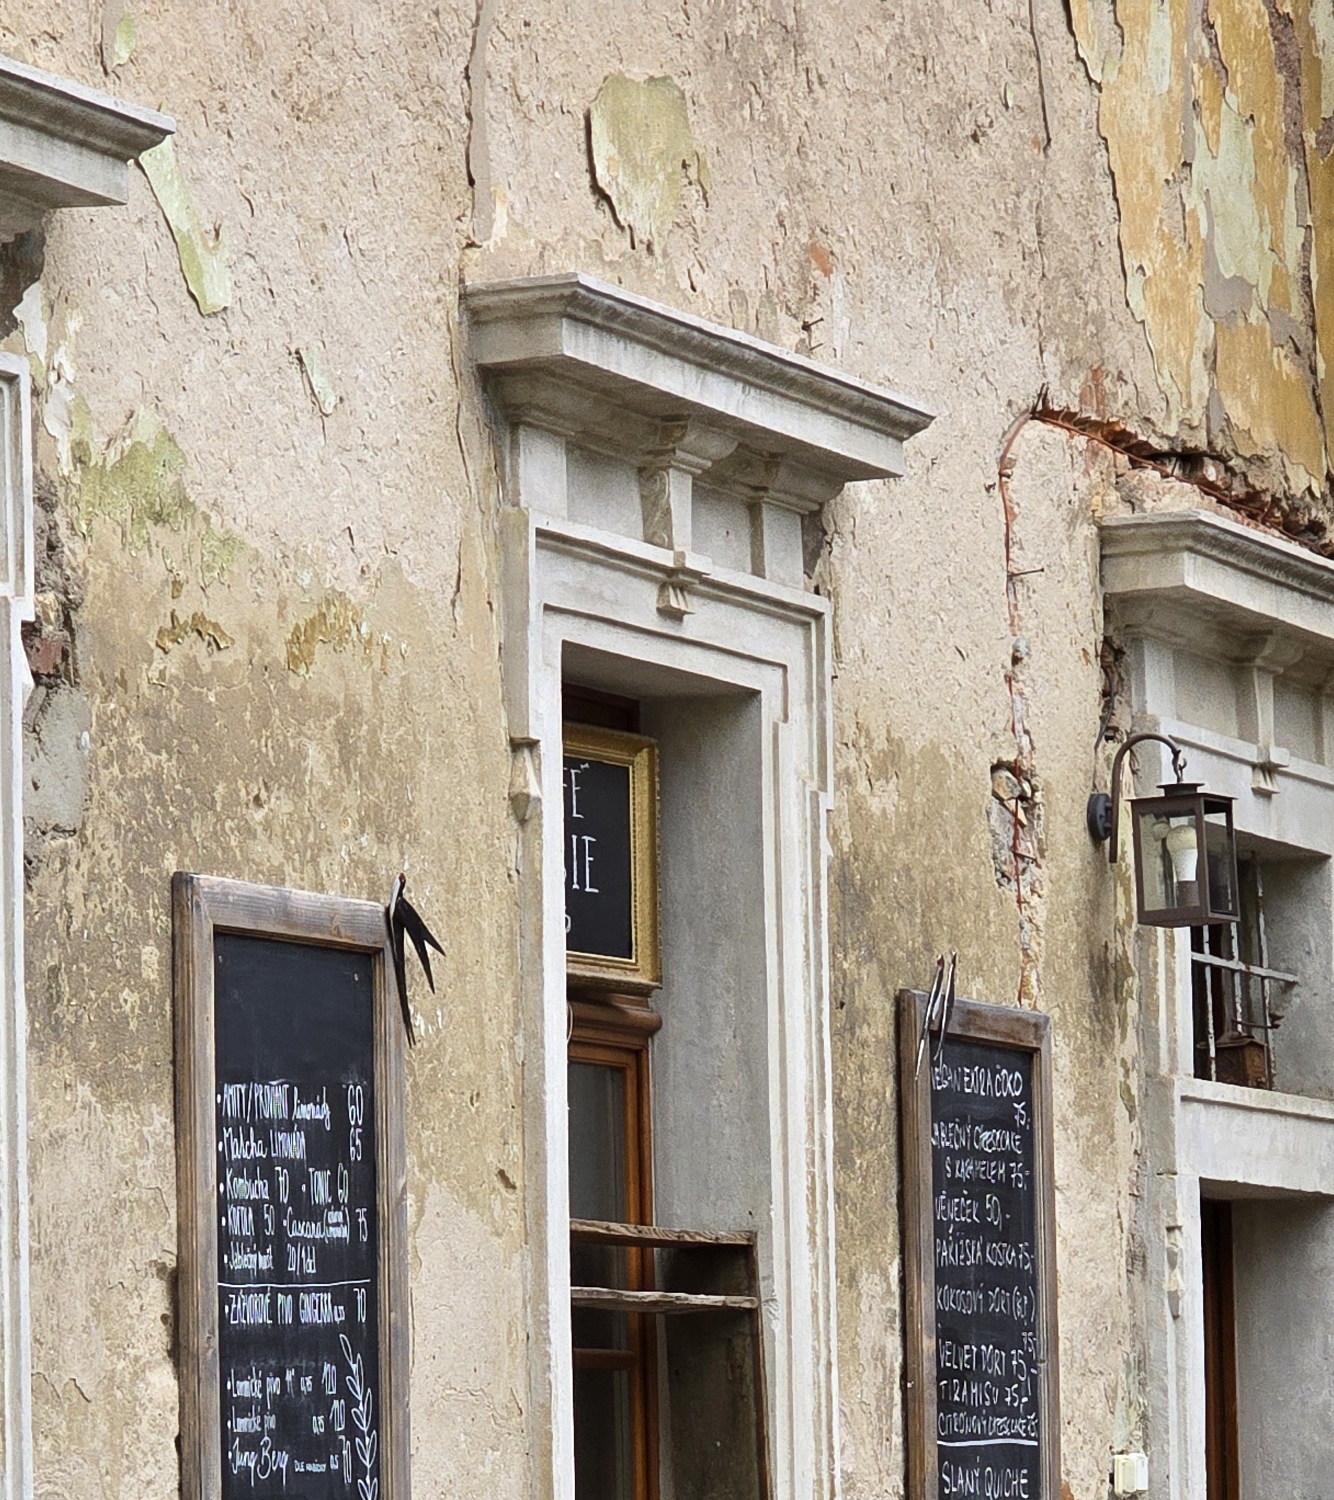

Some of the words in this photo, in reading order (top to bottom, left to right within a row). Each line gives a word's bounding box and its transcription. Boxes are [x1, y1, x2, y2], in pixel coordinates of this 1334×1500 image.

[347, 1085, 364, 1126] 60
[350, 1127, 362, 1161] 65
[226, 1166, 269, 1201] Kombucha
[274, 1166, 289, 1204] 70
[263, 1204, 275, 1236] 50
[355, 1208, 368, 1242] 75
[277, 1293, 293, 1325] PIVO
[353, 1288, 366, 1323] 70
[938, 1338, 977, 1371] VELVET
[980, 1344, 1005, 1377] DORT
[939, 1378, 999, 1408] TIRAMISU
[338, 1435, 351, 1484] 70
[941, 1455, 981, 1497] SLANÝ
